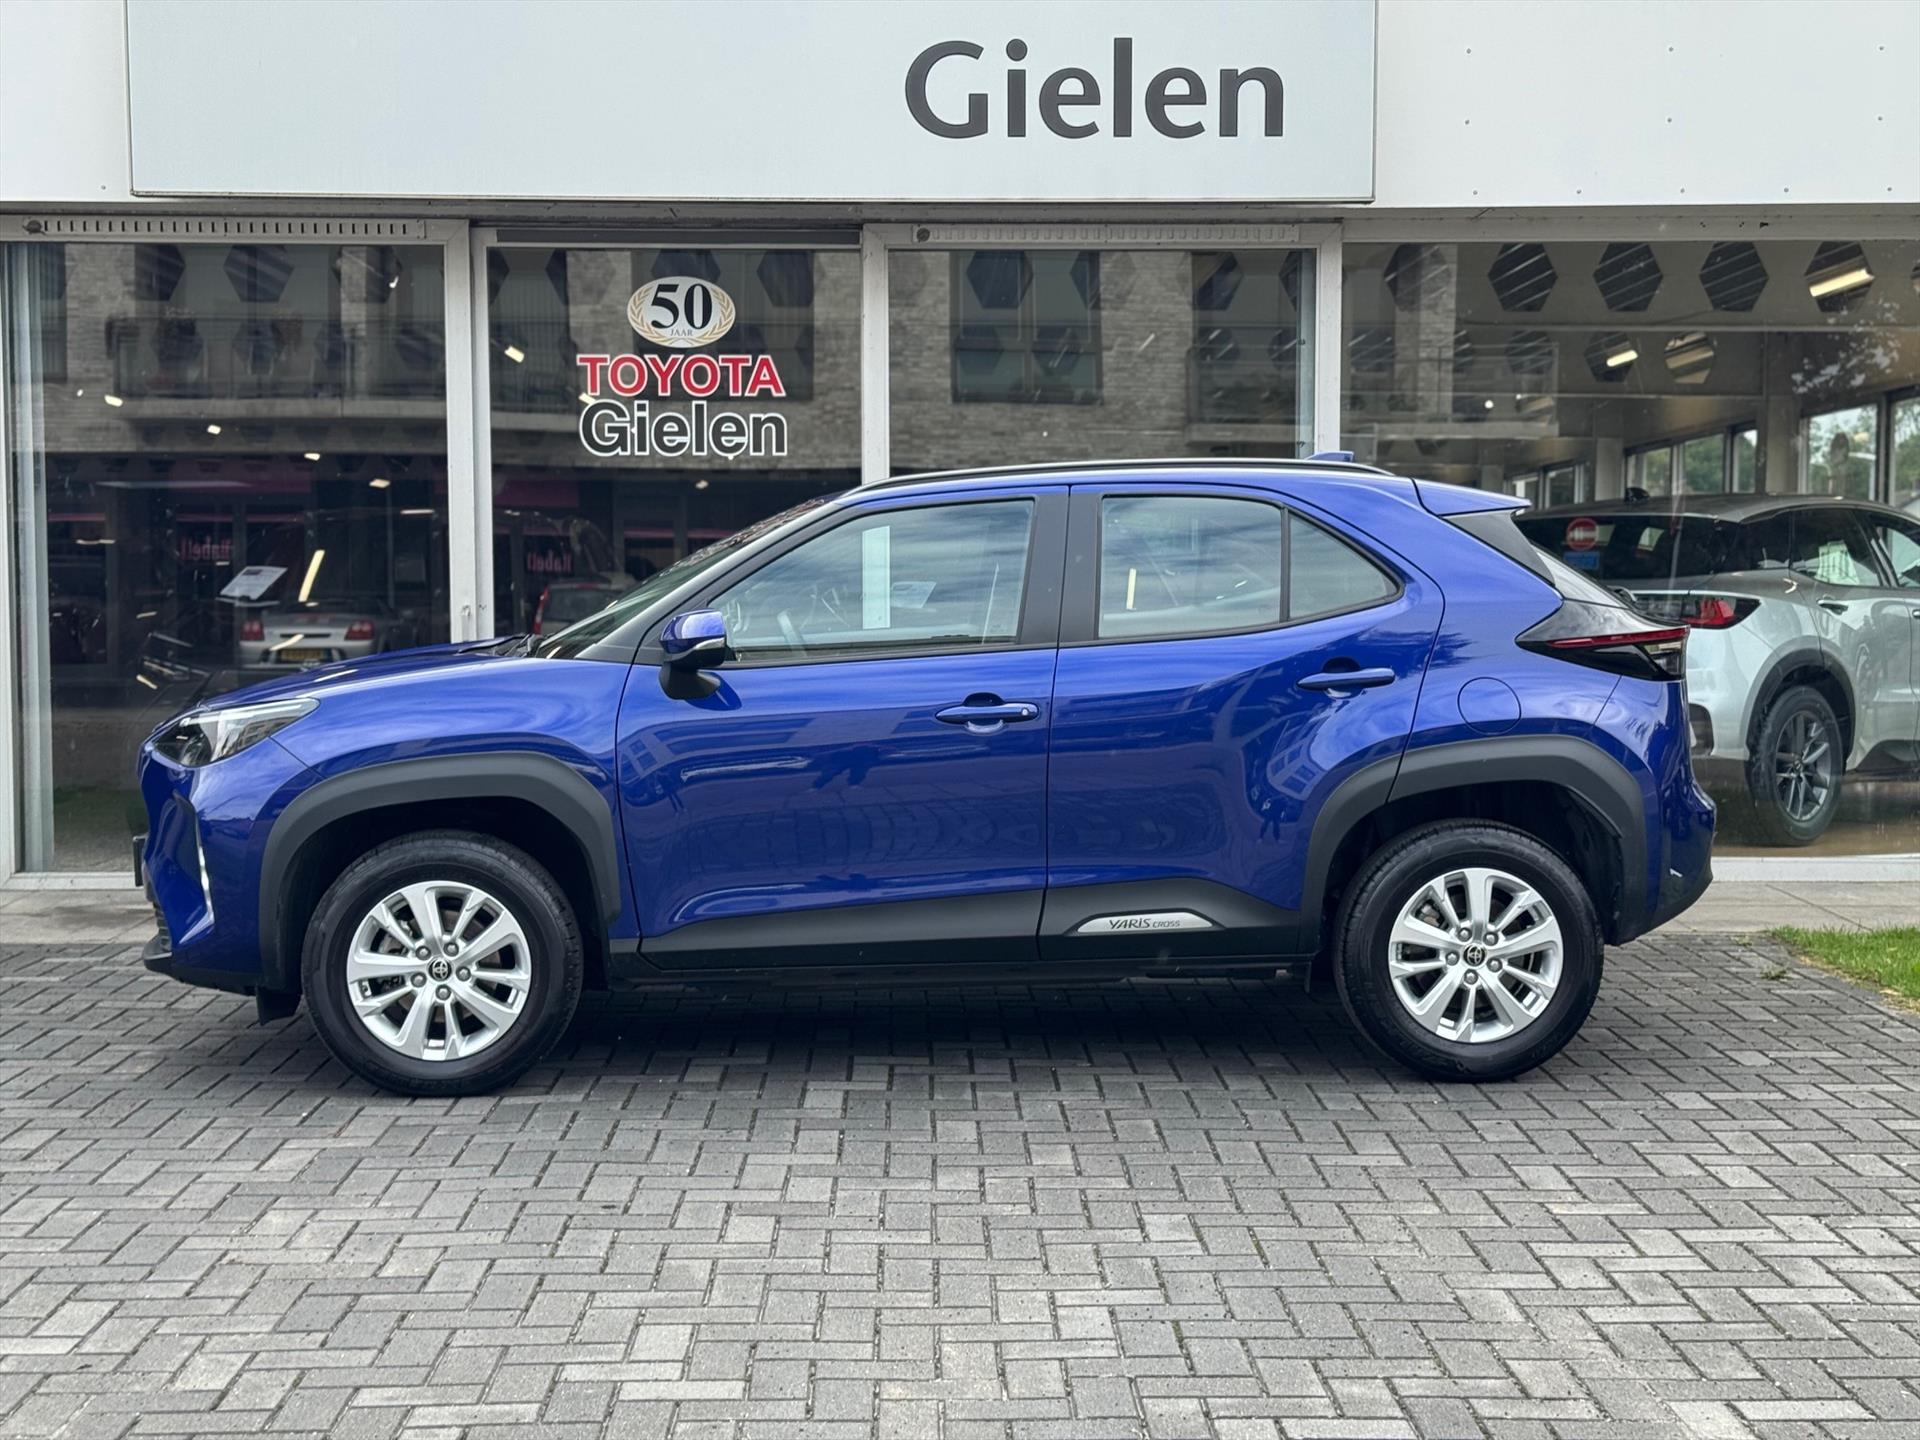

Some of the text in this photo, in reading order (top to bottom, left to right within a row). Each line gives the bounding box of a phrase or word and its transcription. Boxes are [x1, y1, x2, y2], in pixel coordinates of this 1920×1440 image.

[904, 37, 1285, 139] Gielen
[650, 283, 713, 330] 50
[669, 328, 693, 337] JAAR
[576, 354, 787, 397] TOYOTA
[579, 399, 788, 457] Gielen
[1108, 917, 1181, 930] YARIS CROSS
